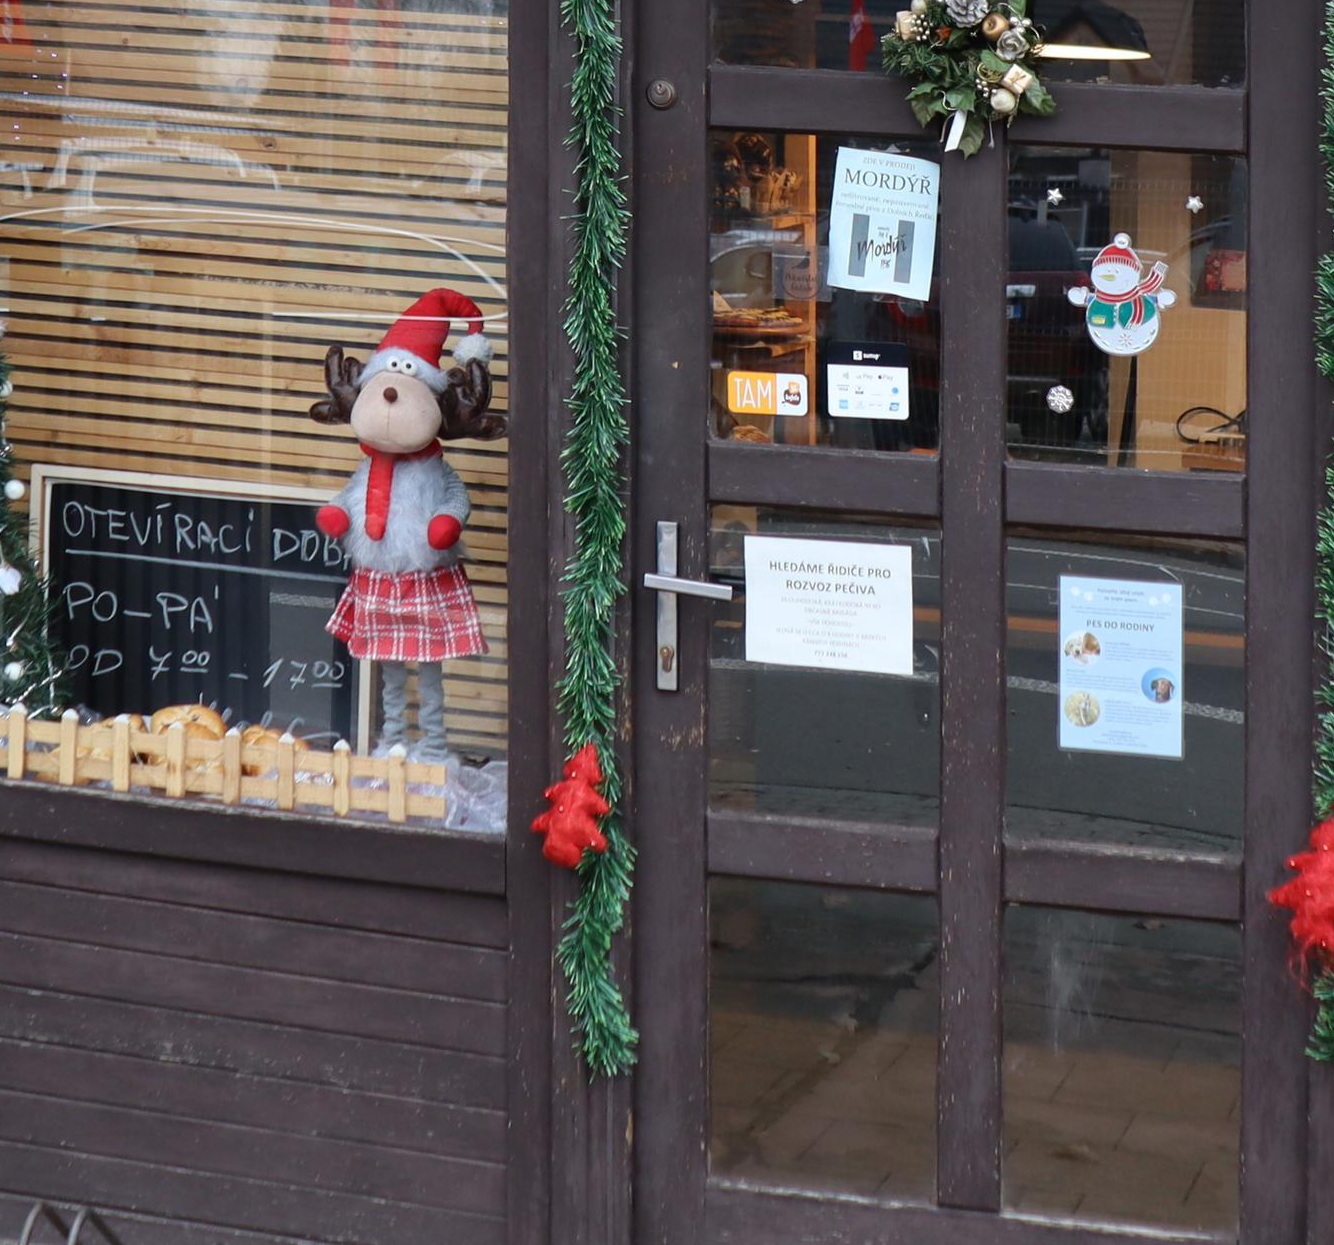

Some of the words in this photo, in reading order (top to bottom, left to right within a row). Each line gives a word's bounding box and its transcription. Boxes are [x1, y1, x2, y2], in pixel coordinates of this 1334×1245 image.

[844, 167, 932, 195] MORDÝŘ
[733, 377, 772, 410] TAM
[769, 560, 824, 575] HLEDÁME
[827, 563, 864, 578] ŘIDIČE
[867, 567, 892, 580] PRO
[785, 579, 831, 593] ROZVOZ
[835, 581, 876, 596] PEČIVA
[1086, 619, 1102, 629] PES
[1104, 620, 1118, 629] DO
[1120, 622, 1155, 633] RODINY
[66, 643, 124, 677] OD
